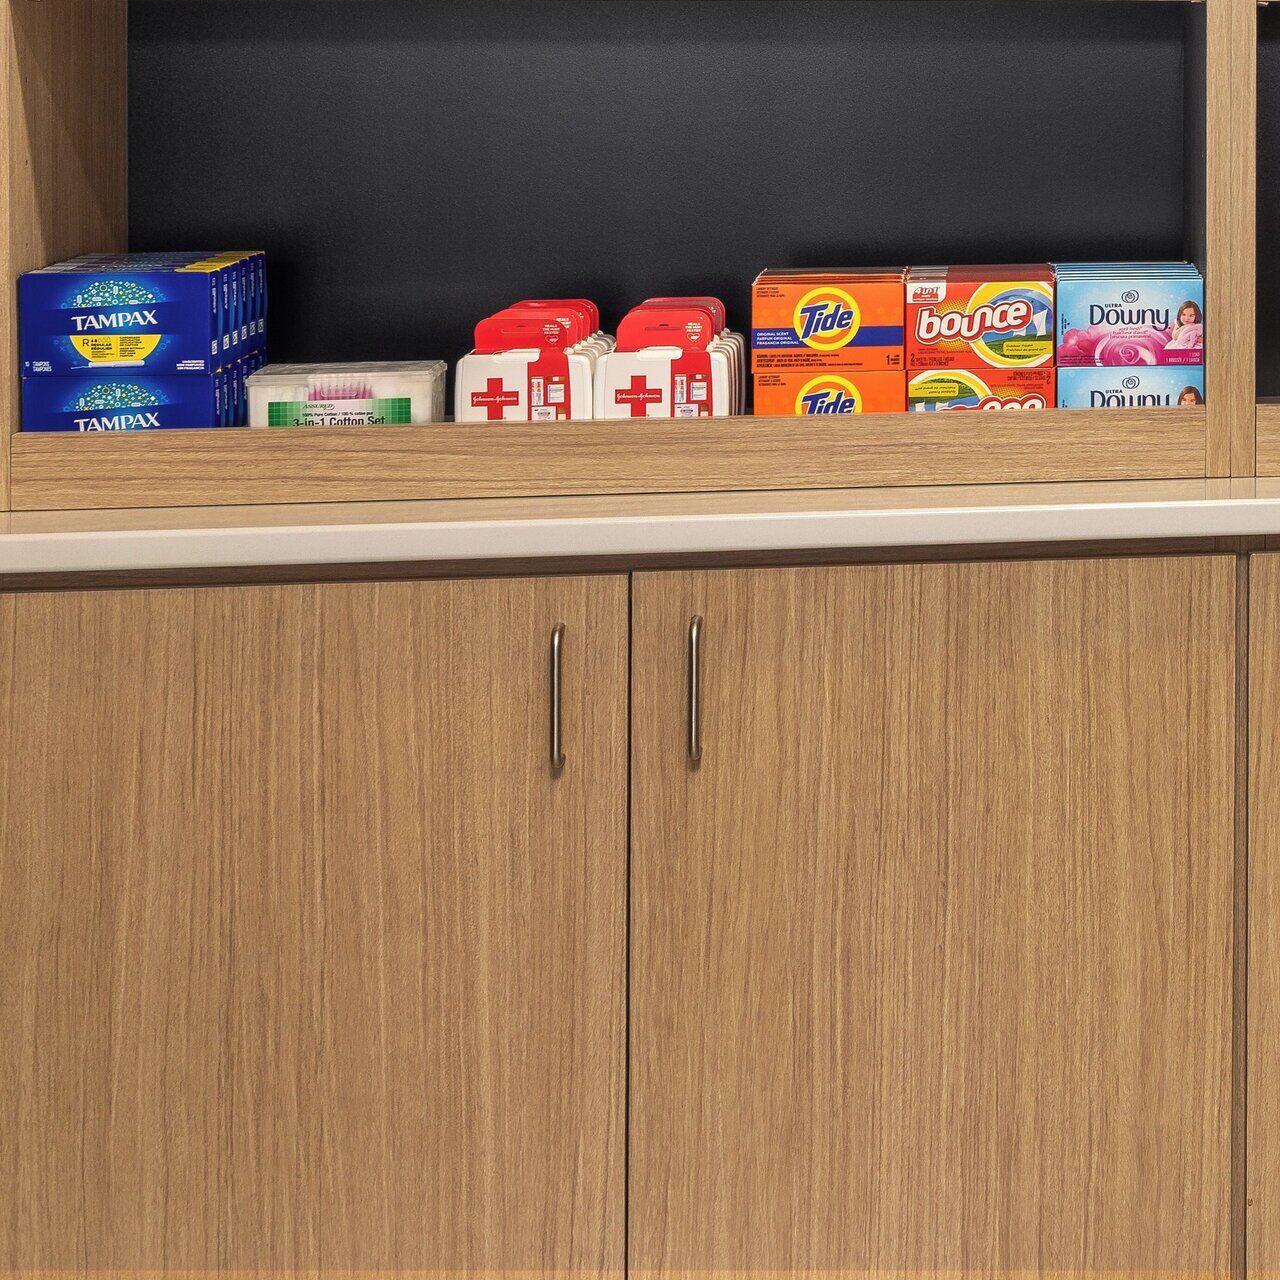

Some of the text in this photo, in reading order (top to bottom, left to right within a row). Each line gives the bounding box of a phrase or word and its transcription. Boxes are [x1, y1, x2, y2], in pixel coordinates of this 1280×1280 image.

[71, 310, 158, 331] TAMPAX
[800, 303, 854, 341] Tide
[918, 302, 1027, 339] bounce
[1090, 304, 1169, 331] Downy
[801, 391, 855, 414] Tide
[1090, 391, 1170, 408] Downy
[73, 412, 160, 431] TAMPAX
[292, 416, 385, 426] 3-in-1 Cotton Set
